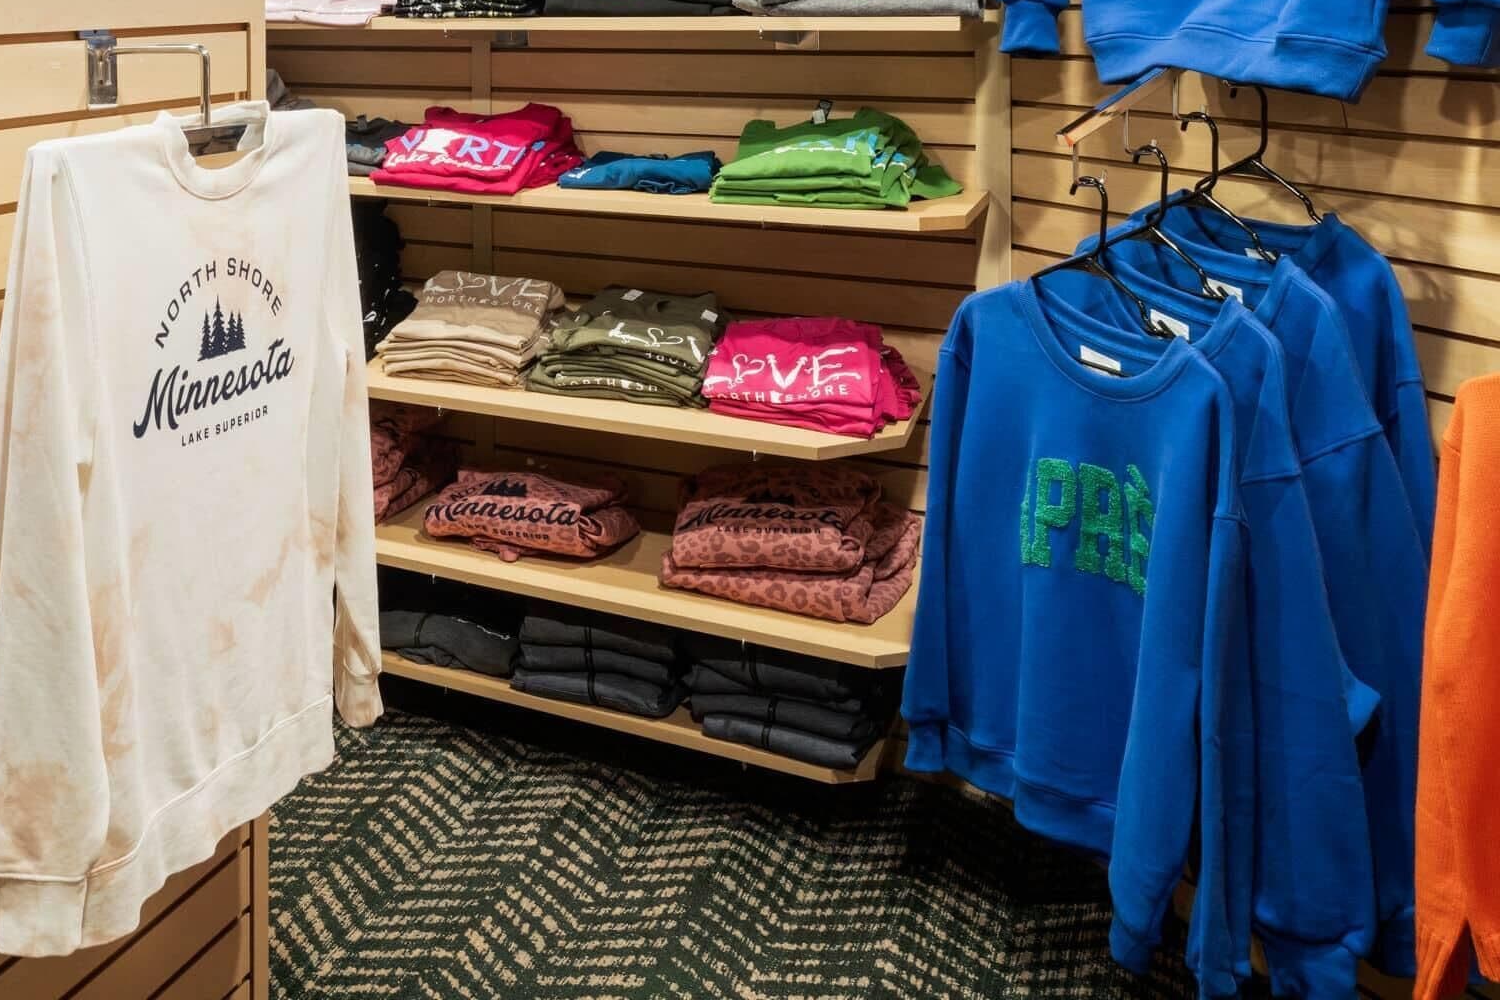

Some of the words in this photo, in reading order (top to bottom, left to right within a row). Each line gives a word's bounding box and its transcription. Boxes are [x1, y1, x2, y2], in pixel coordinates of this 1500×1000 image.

[386, 152, 430, 167] Lake
[155, 260, 217, 349] NORTH
[227, 257, 283, 317] SHORE
[425, 295, 477, 305] NORTH
[132, 337, 295, 439] Minnesota
[181, 427, 210, 447] LAKE
[215, 405, 269, 435] SUPERIOR
[425, 499, 581, 527] Minnesota
[716, 525, 749, 534] LAKE
